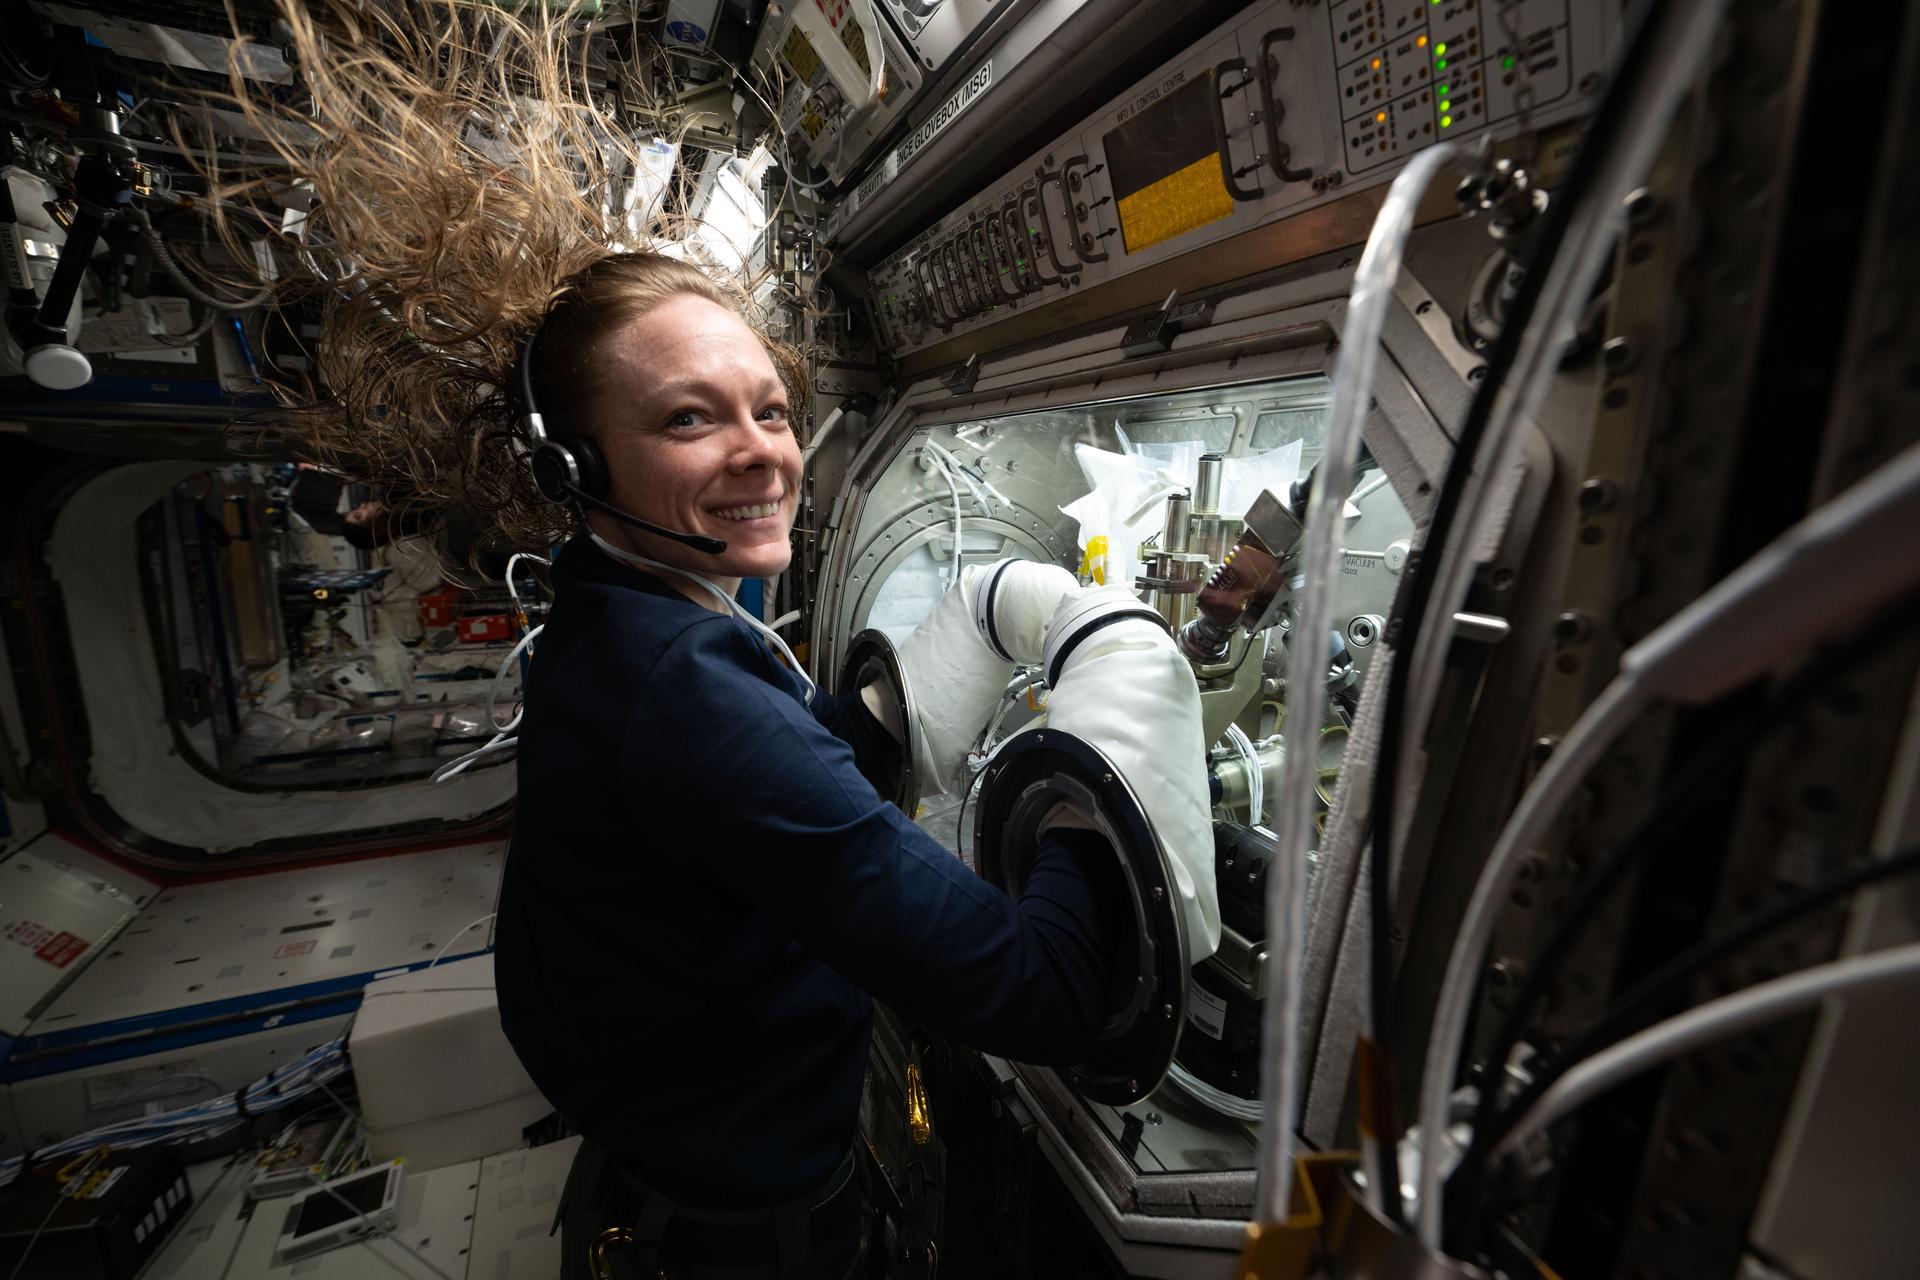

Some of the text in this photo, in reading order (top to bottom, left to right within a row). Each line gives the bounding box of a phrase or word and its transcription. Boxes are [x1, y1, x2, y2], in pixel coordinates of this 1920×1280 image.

[914, 93, 960, 149] GLOVEBOX
[961, 63, 991, 105] (MSG)
[1116, 108, 1129, 123] INFO
[1136, 88, 1161, 110] CONTROL
[1162, 70, 1186, 94] CENTRE
[1345, 557, 1376, 569] VACUUM
